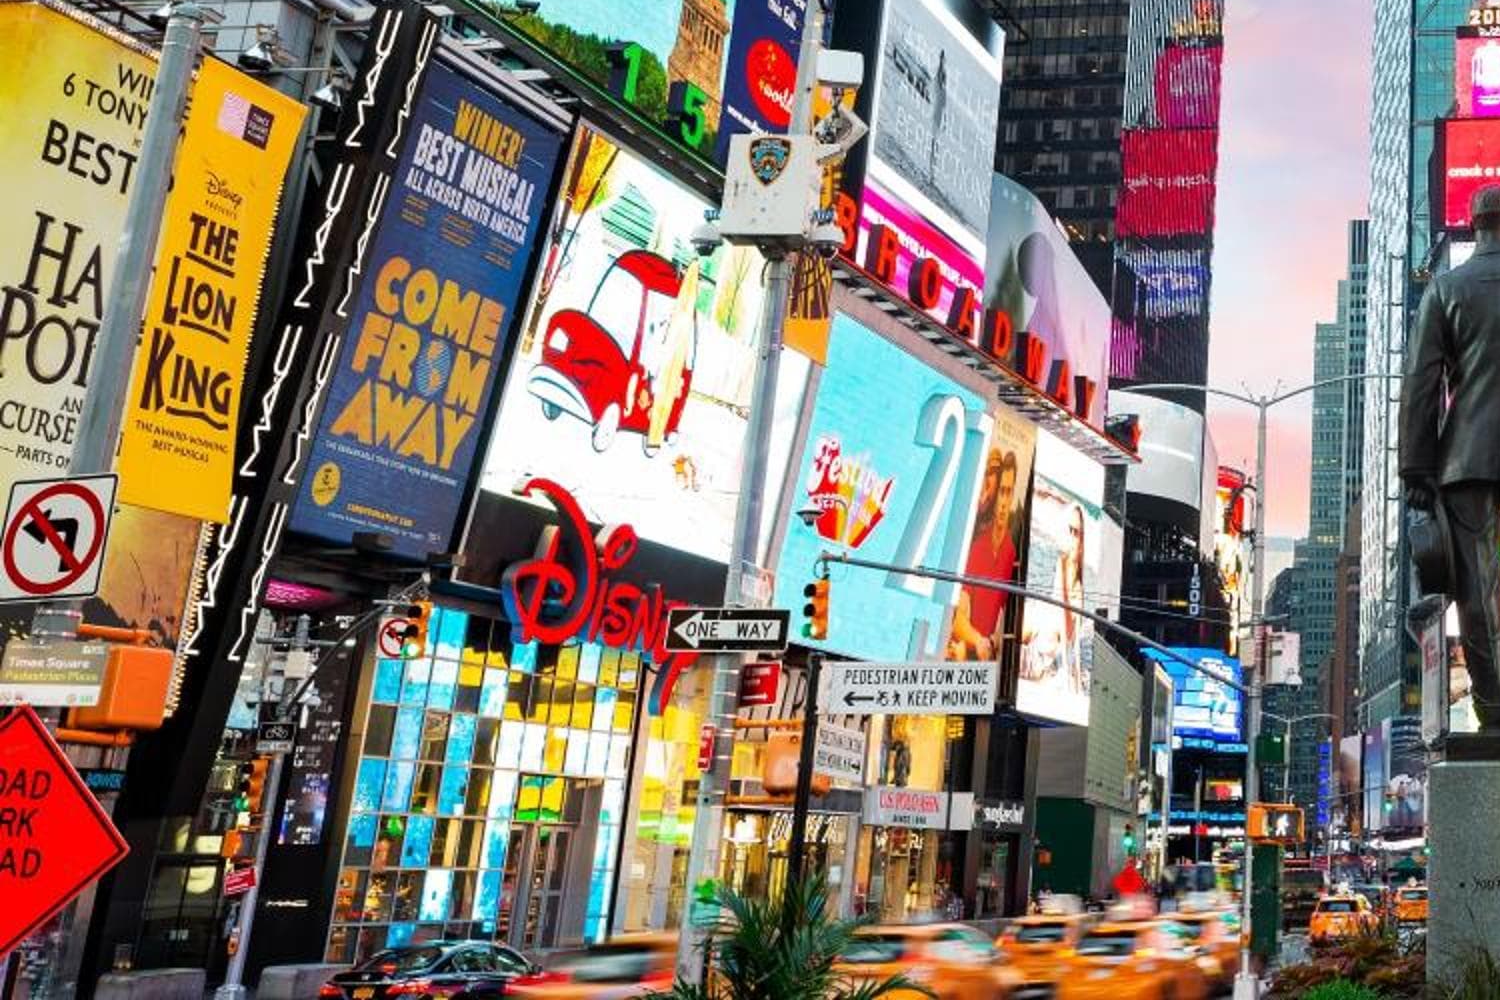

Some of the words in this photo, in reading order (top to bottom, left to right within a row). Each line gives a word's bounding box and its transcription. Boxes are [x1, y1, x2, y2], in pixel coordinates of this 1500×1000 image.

[63, 72, 77, 97] 6
[85, 79, 150, 130] TONY
[41, 119, 138, 195] BEST
[454, 98, 526, 171] WINNER!
[404, 167, 425, 193] ALL
[413, 123, 465, 182] BEST
[460, 149, 535, 224] MUSICAL
[190, 212, 239, 266] THE
[162, 256, 237, 332] LION
[373, 257, 506, 359] COME
[832, 190, 1097, 423] BROADWAY
[139, 328, 232, 416] KING
[351, 311, 495, 416] FROM
[15, 445, 52, 465] PARTS
[330, 381, 476, 472] AWAY
[686, 620, 719, 640] ONE
[736, 620, 773, 640] WAY
[8, 656, 45, 669] Times
[47, 657, 90, 671] Square
[843, 669, 919, 685] PEDESTRIAN
[922, 669, 954, 685] FLOW
[957, 669, 989, 685] ZONE
[907, 690, 937, 706] KEEP
[942, 690, 987, 706] MOVING
[0, 769, 52, 800] AD
